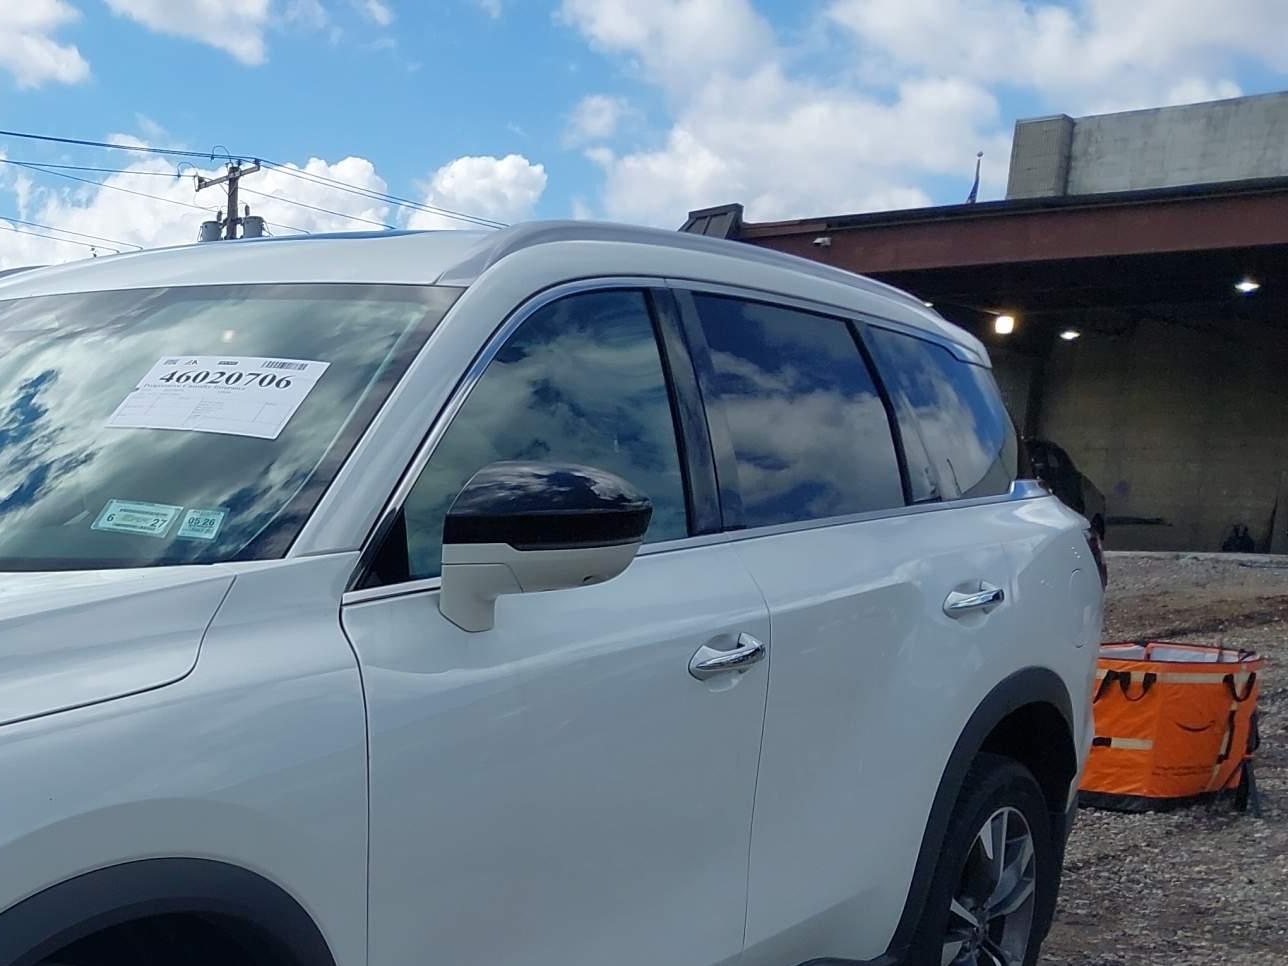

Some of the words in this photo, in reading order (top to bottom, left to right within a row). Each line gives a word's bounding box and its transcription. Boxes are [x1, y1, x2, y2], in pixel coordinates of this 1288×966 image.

[159, 370, 296, 390] 46020706
[106, 513, 116, 522] 6
[149, 518, 168, 529] 27
